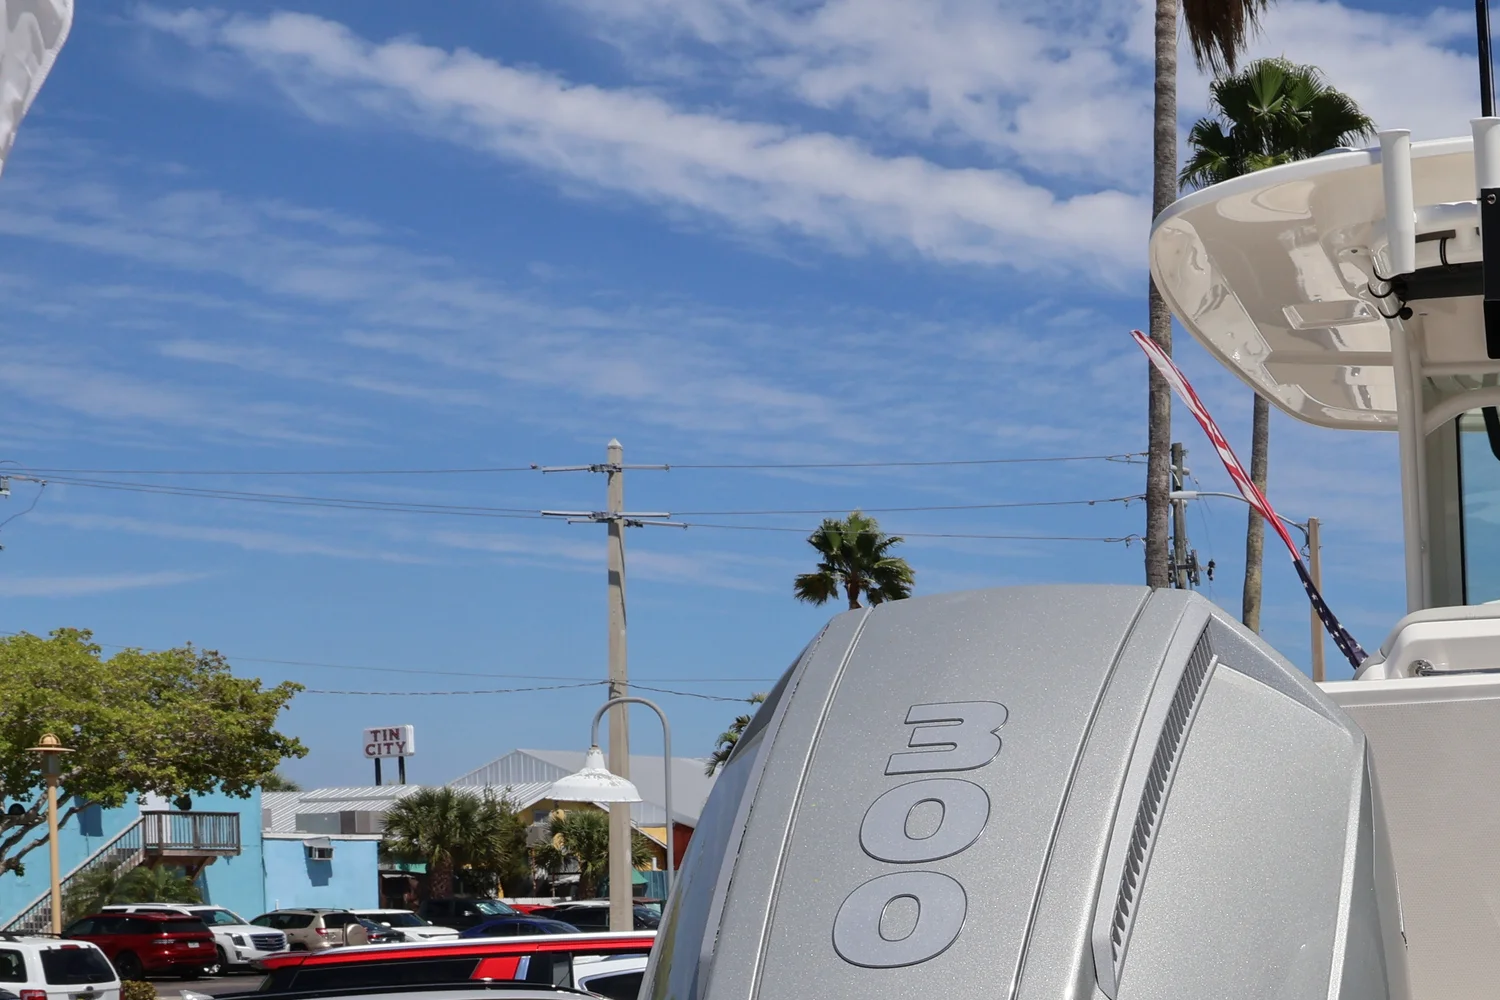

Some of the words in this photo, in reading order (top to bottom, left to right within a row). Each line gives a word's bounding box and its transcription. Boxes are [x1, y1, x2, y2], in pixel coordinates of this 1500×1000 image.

[370, 728, 400, 742] TIN
[365, 741, 406, 756] CITY
[832, 700, 1009, 969] 300
